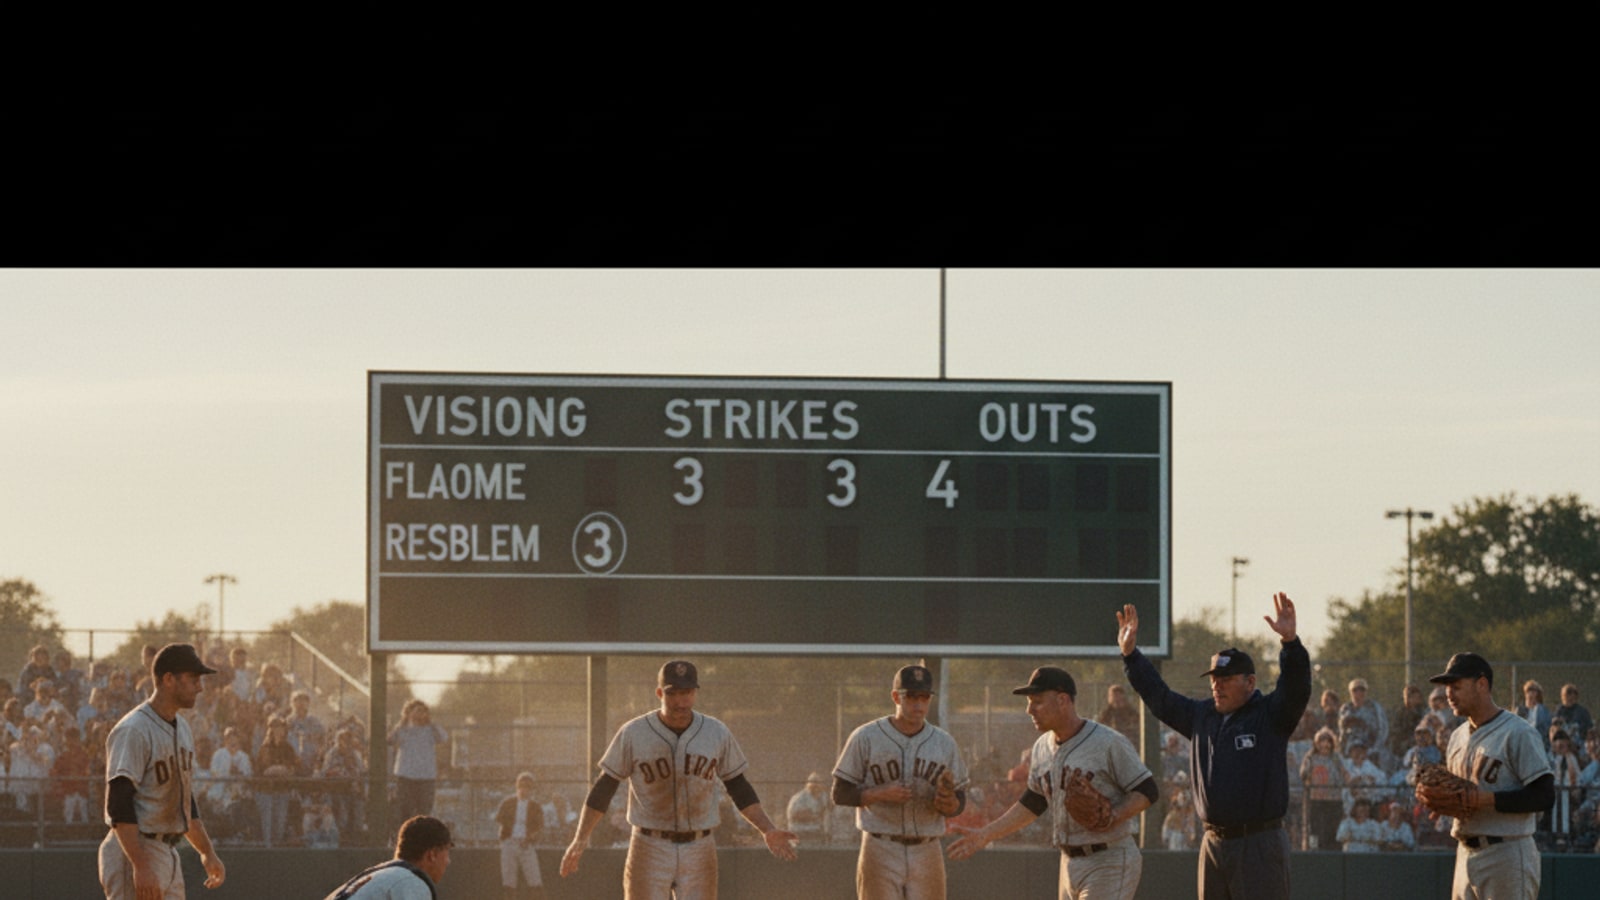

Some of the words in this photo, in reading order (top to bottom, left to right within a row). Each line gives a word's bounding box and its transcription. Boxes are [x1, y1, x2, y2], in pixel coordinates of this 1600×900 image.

[404, 395, 587, 438] VISIONG
[664, 398, 860, 441] STRIKES
[979, 402, 1097, 444] OUTS
[673, 457, 704, 507] 3
[827, 459, 857, 508] 3
[926, 460, 960, 509] 4
[385, 522, 540, 563] RESBLEM
[582, 519, 613, 568] 3
